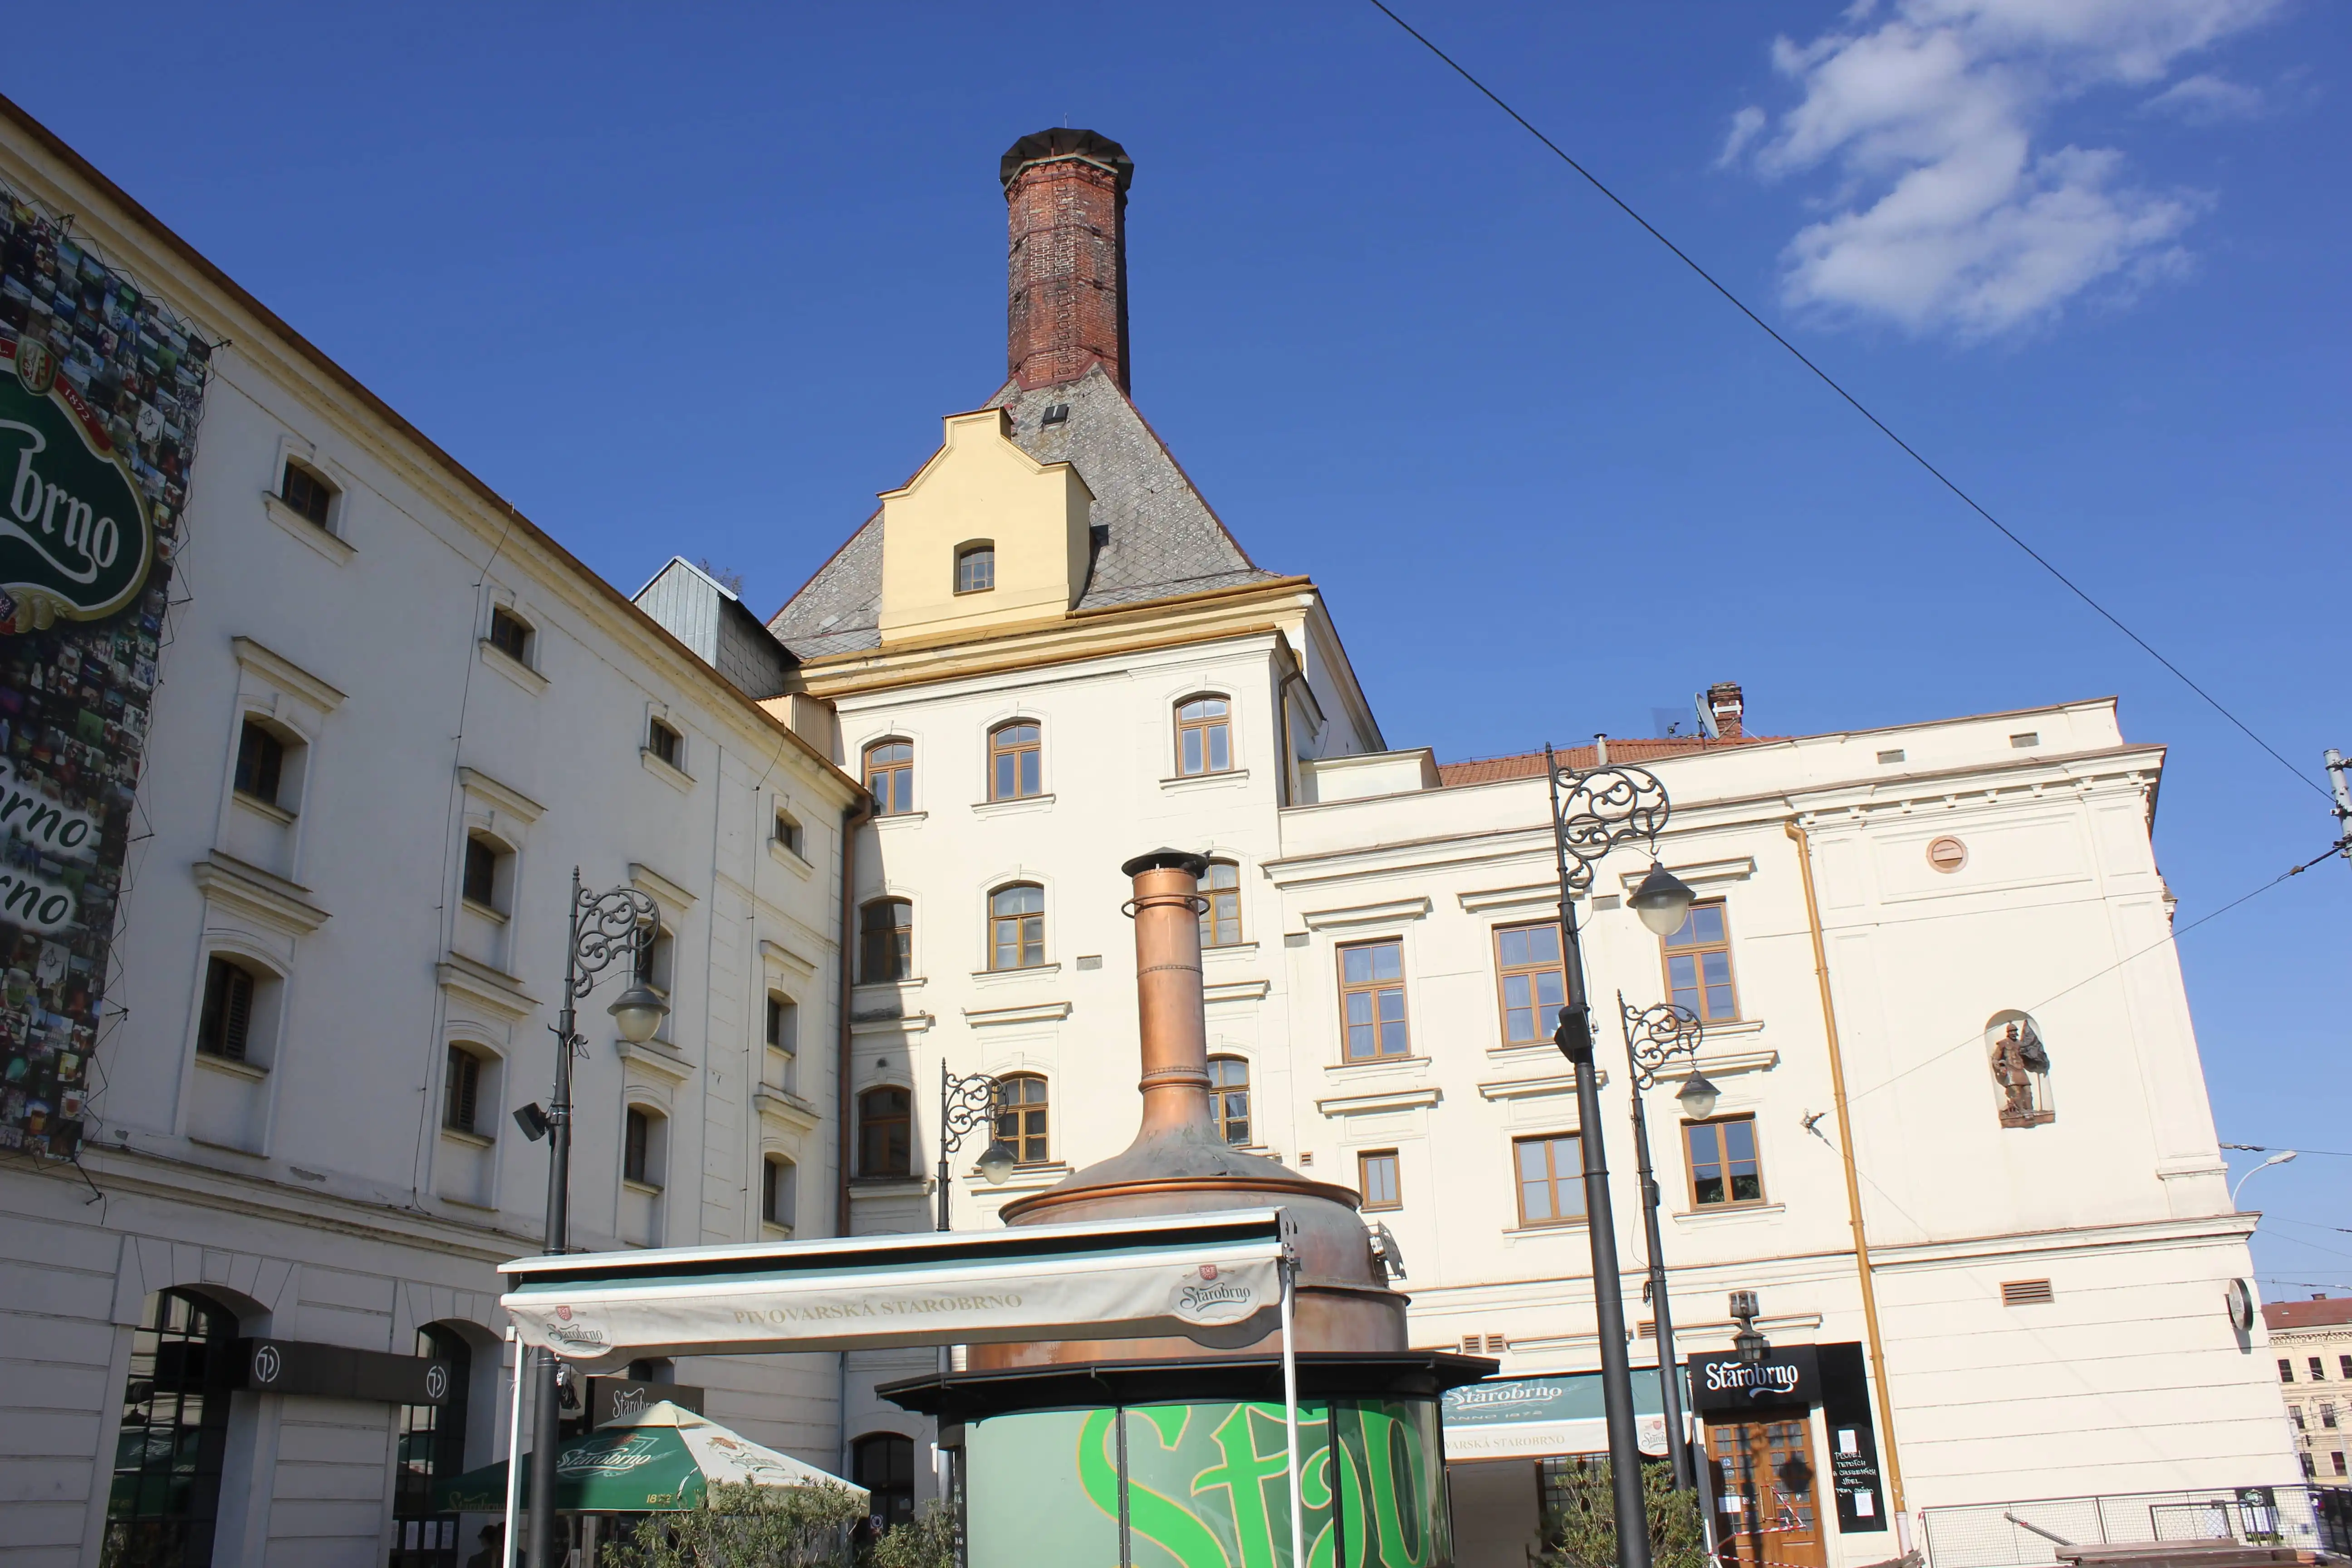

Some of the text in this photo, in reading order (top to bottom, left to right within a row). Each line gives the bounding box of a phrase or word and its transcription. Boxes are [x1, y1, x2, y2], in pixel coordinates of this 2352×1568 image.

[65, 389, 90, 421] 1872
[0, 765, 88, 848] rno
[733, 1294, 1022, 1324] PIVOVARSKÁ STAROBRNO
[1180, 1282, 1250, 1312] Starobrno
[547, 1323, 603, 1344] Starobrno
[1705, 1361, 1798, 1398] Starobrno
[613, 1387, 656, 1418] Starobr
[1442, 1382, 1563, 1410] Starobrno
[1494, 1436, 1565, 1448] STAROBRNO
[557, 1447, 652, 1473] Starobrno
